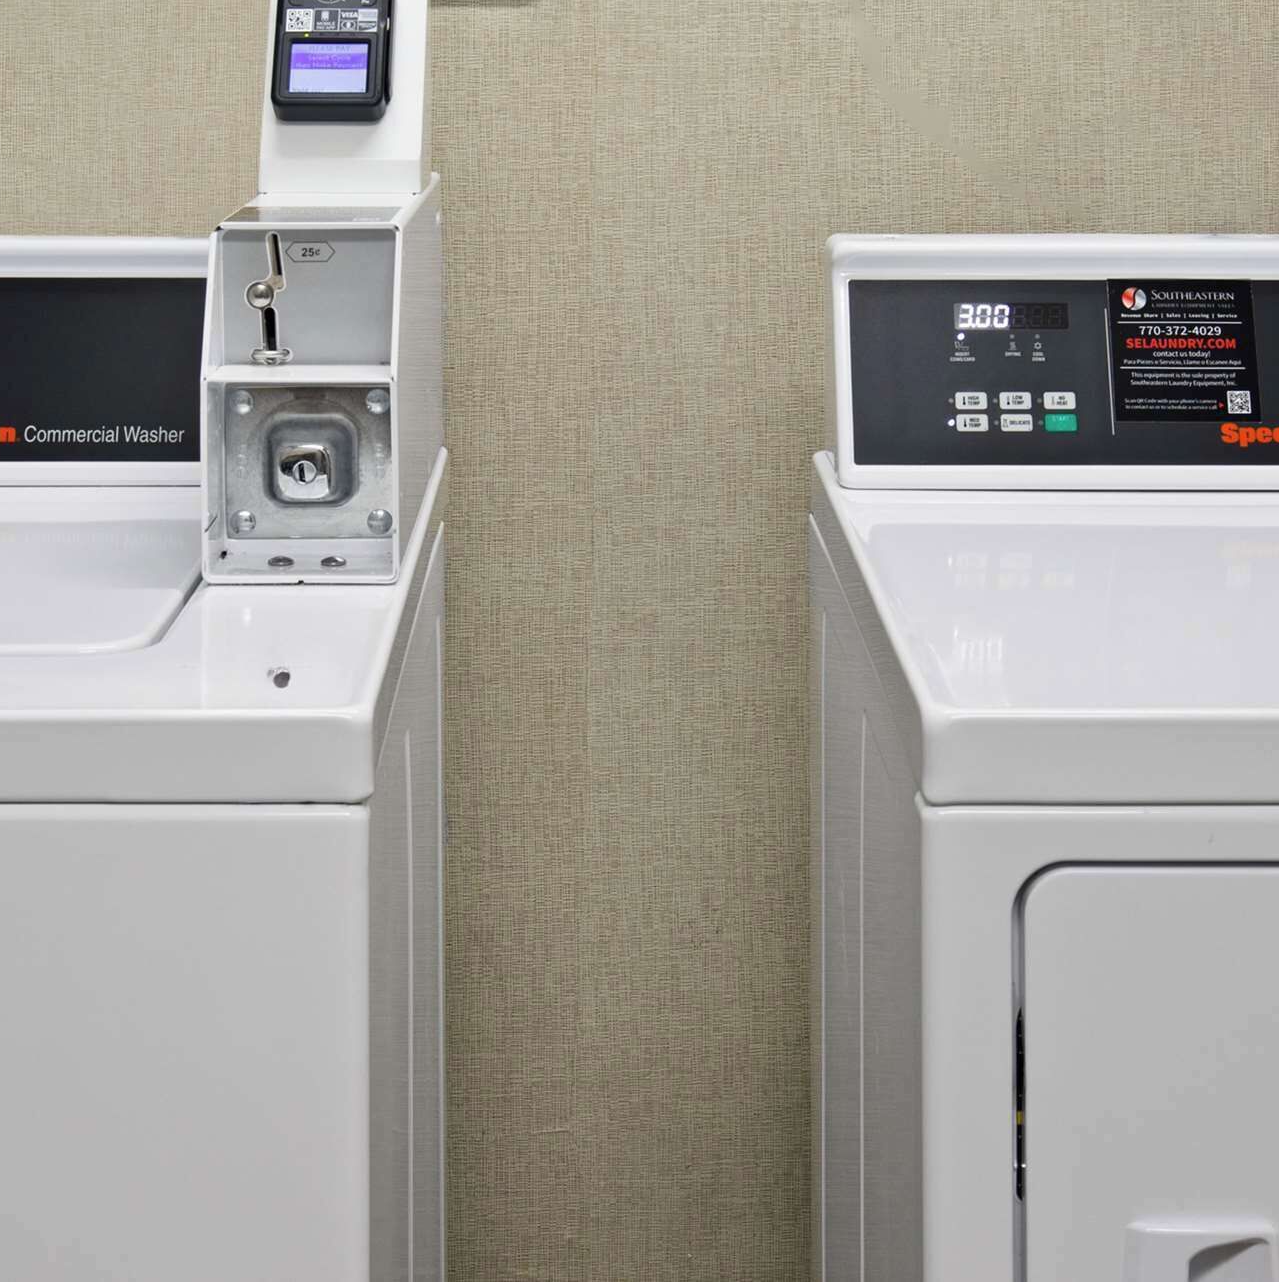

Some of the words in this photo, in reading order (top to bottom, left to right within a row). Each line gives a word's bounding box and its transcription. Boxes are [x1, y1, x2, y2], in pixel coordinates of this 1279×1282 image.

[959, 304, 1010, 329] 3.00
[1139, 326, 1222, 336] 770-372-4029
[1125, 338, 1237, 349] SELAUNDRY.COM
[1188, 350, 1211, 359] today!
[1204, 372, 1229, 380] property
[1169, 379, 1192, 387] Laundry
[23, 424, 120, 444] Commercial
[123, 425, 185, 444] Washer
